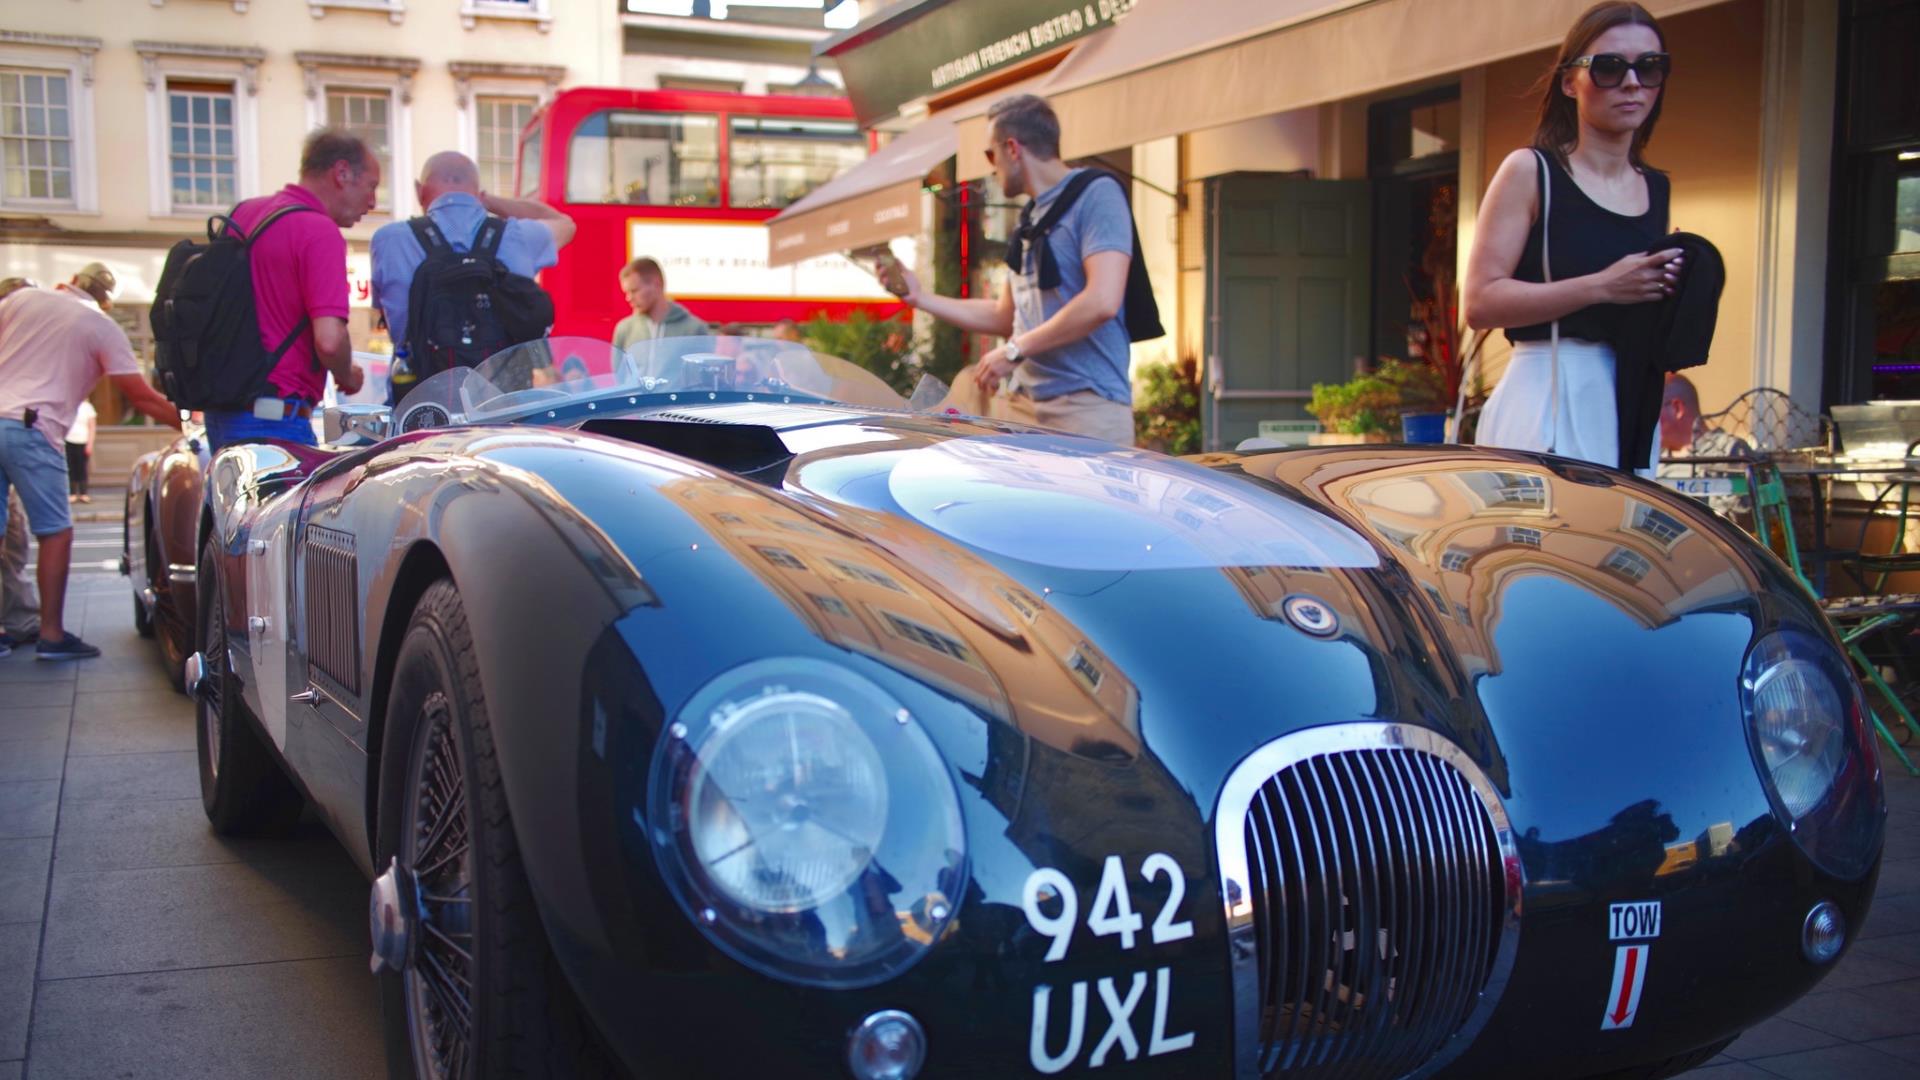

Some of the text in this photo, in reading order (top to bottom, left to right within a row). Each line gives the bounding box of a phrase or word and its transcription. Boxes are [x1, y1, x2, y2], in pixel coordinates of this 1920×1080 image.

[931, 51, 981, 88] ARTISAN
[979, 31, 1031, 68] FRENCH
[1030, 9, 1083, 48] BISTRO
[1084, 4, 1097, 26] &
[1023, 853, 1194, 962] 942
[1611, 904, 1658, 938] TOW
[1030, 967, 1195, 1074] UXL
